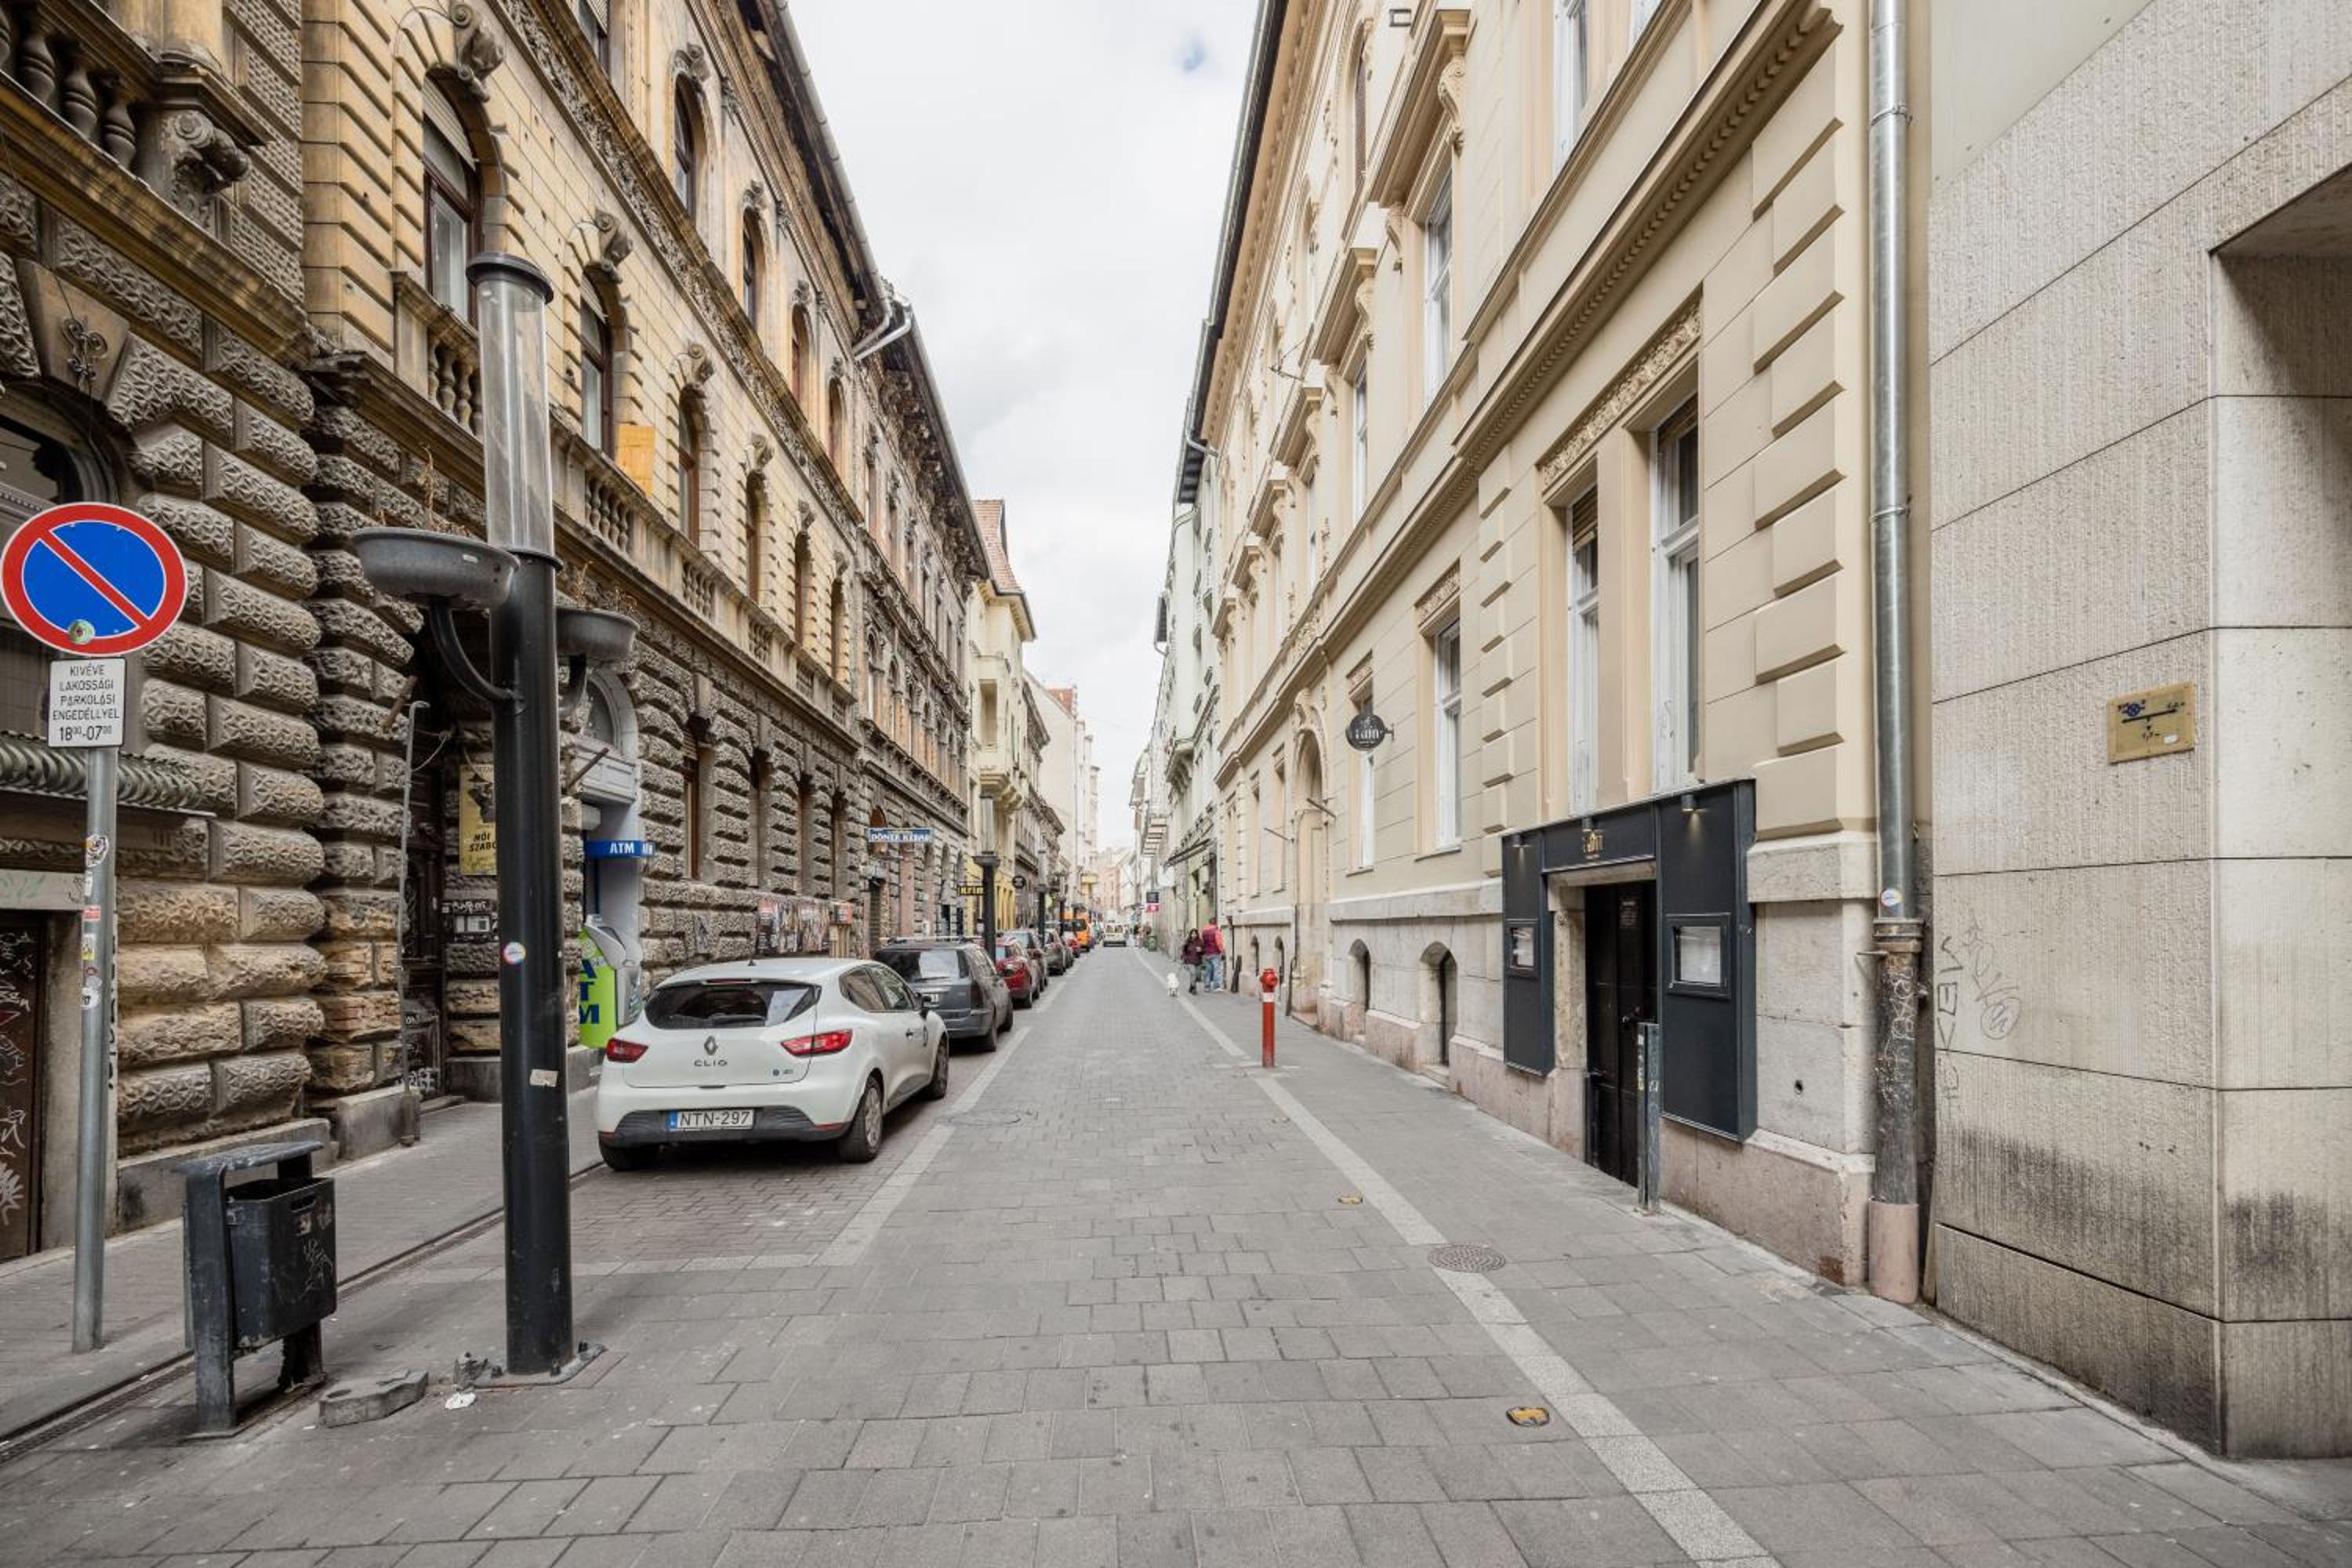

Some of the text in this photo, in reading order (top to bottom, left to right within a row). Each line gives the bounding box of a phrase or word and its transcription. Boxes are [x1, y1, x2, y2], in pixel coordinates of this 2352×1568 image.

[70, 662, 106, 677] KIVÉVE
[59, 677, 114, 692] LAKOSSÁGI
[60, 691, 115, 706] PARKOLÁSI
[53, 706, 120, 720] ENGEDÉLLYEL
[609, 842, 634, 854] ATM
[680, 1110, 750, 1127] NTN-297
